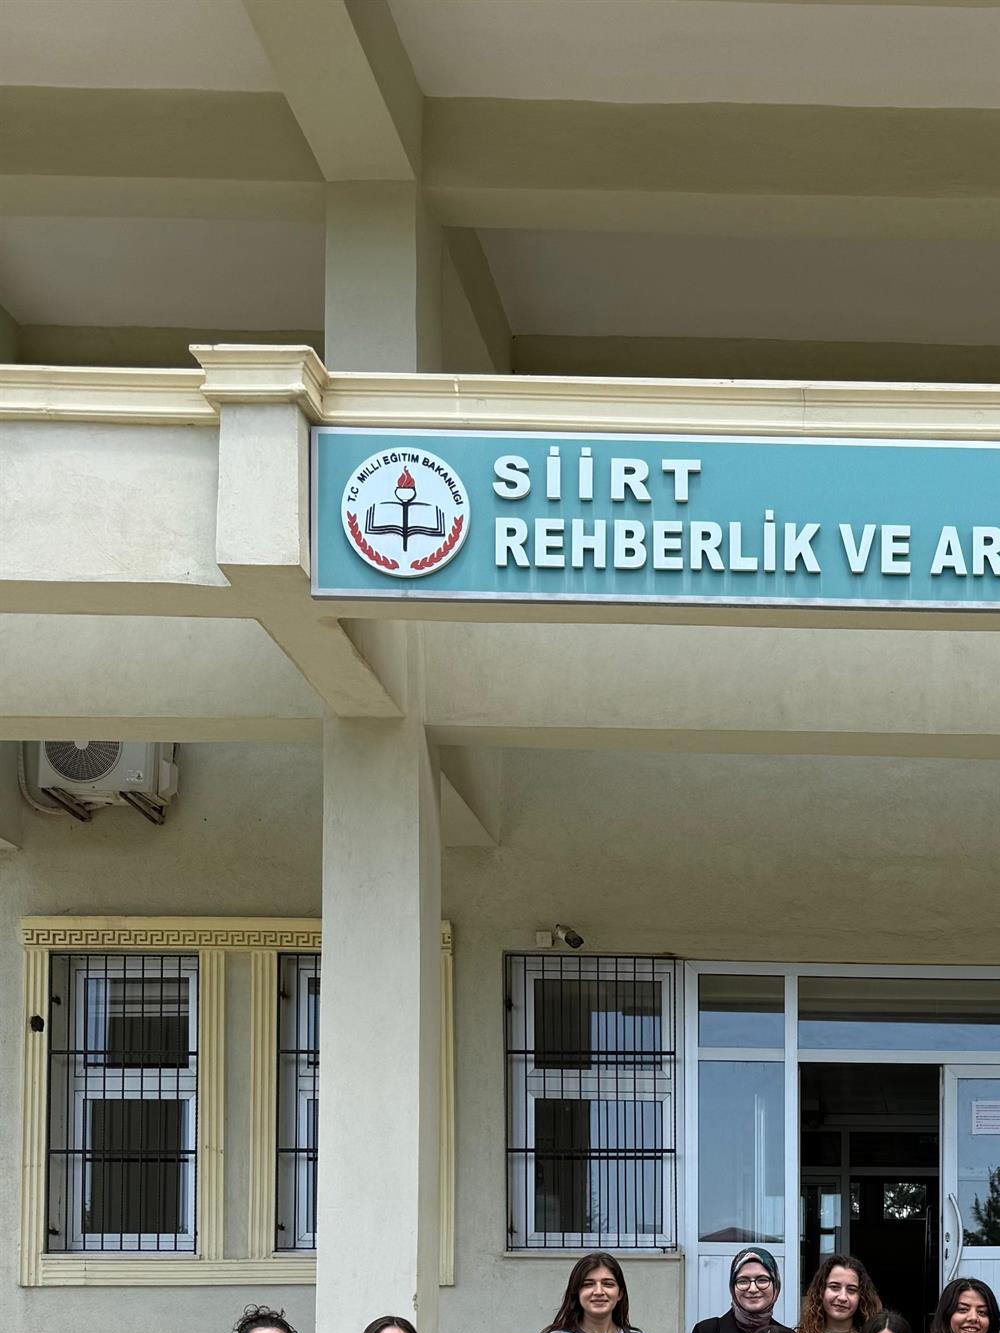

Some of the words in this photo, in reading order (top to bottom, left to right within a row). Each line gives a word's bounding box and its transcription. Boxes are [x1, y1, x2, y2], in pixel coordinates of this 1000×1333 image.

[492, 446, 702, 500] SİİRT
[494, 507, 822, 573] REHBERLİK
[839, 523, 912, 574] VE
